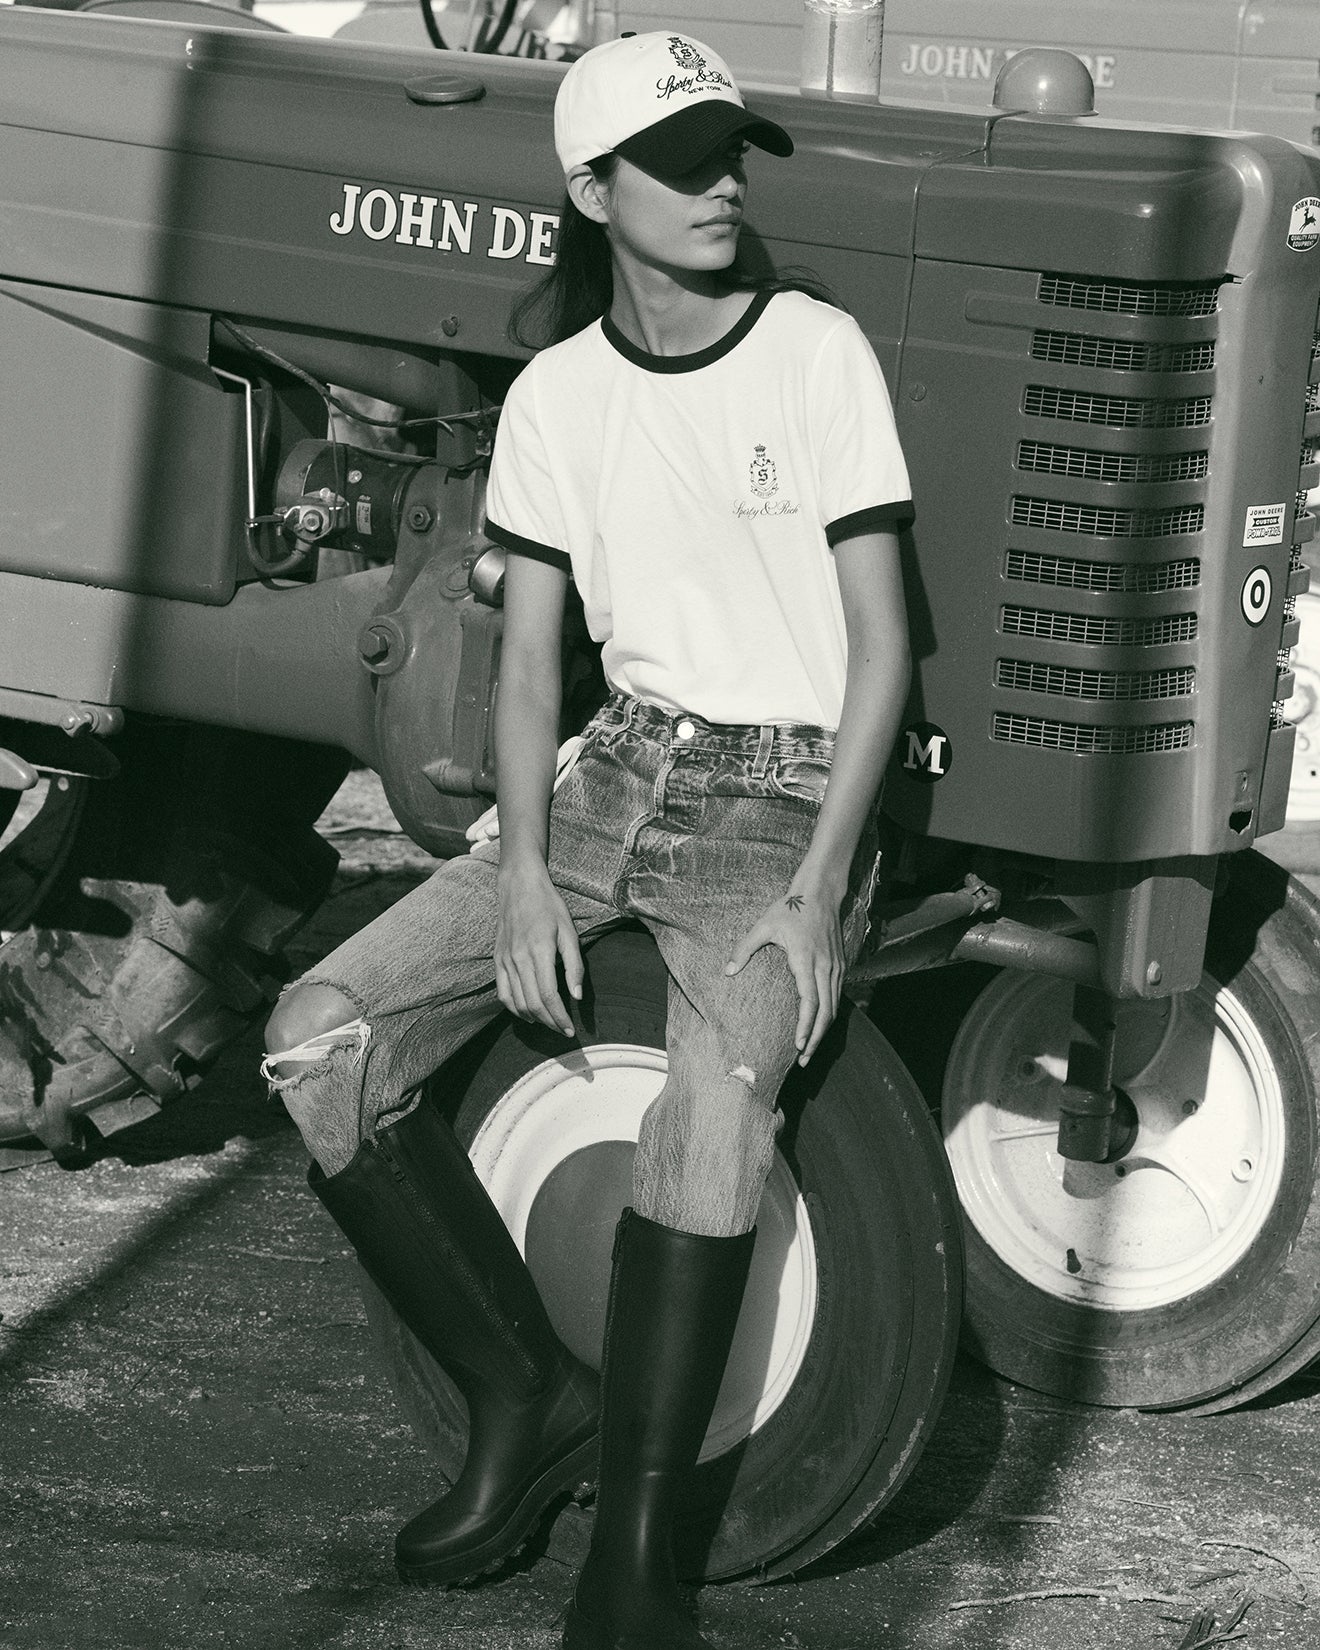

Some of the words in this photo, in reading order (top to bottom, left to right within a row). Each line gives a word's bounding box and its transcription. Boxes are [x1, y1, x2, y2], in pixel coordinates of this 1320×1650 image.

[901, 44, 994, 79] JOHN
[656, 75, 695, 100] Sporty
[696, 69, 711, 82] &
[688, 86, 704, 94] NEW
[329, 183, 478, 255] JOHN
[487, 206, 561, 266] DE
[732, 500, 760, 520] Sporty
[760, 501, 777, 516] &
[777, 500, 801, 515] Rich
[1268, 507, 1284, 515] DEERE
[903, 731, 946, 775] M
